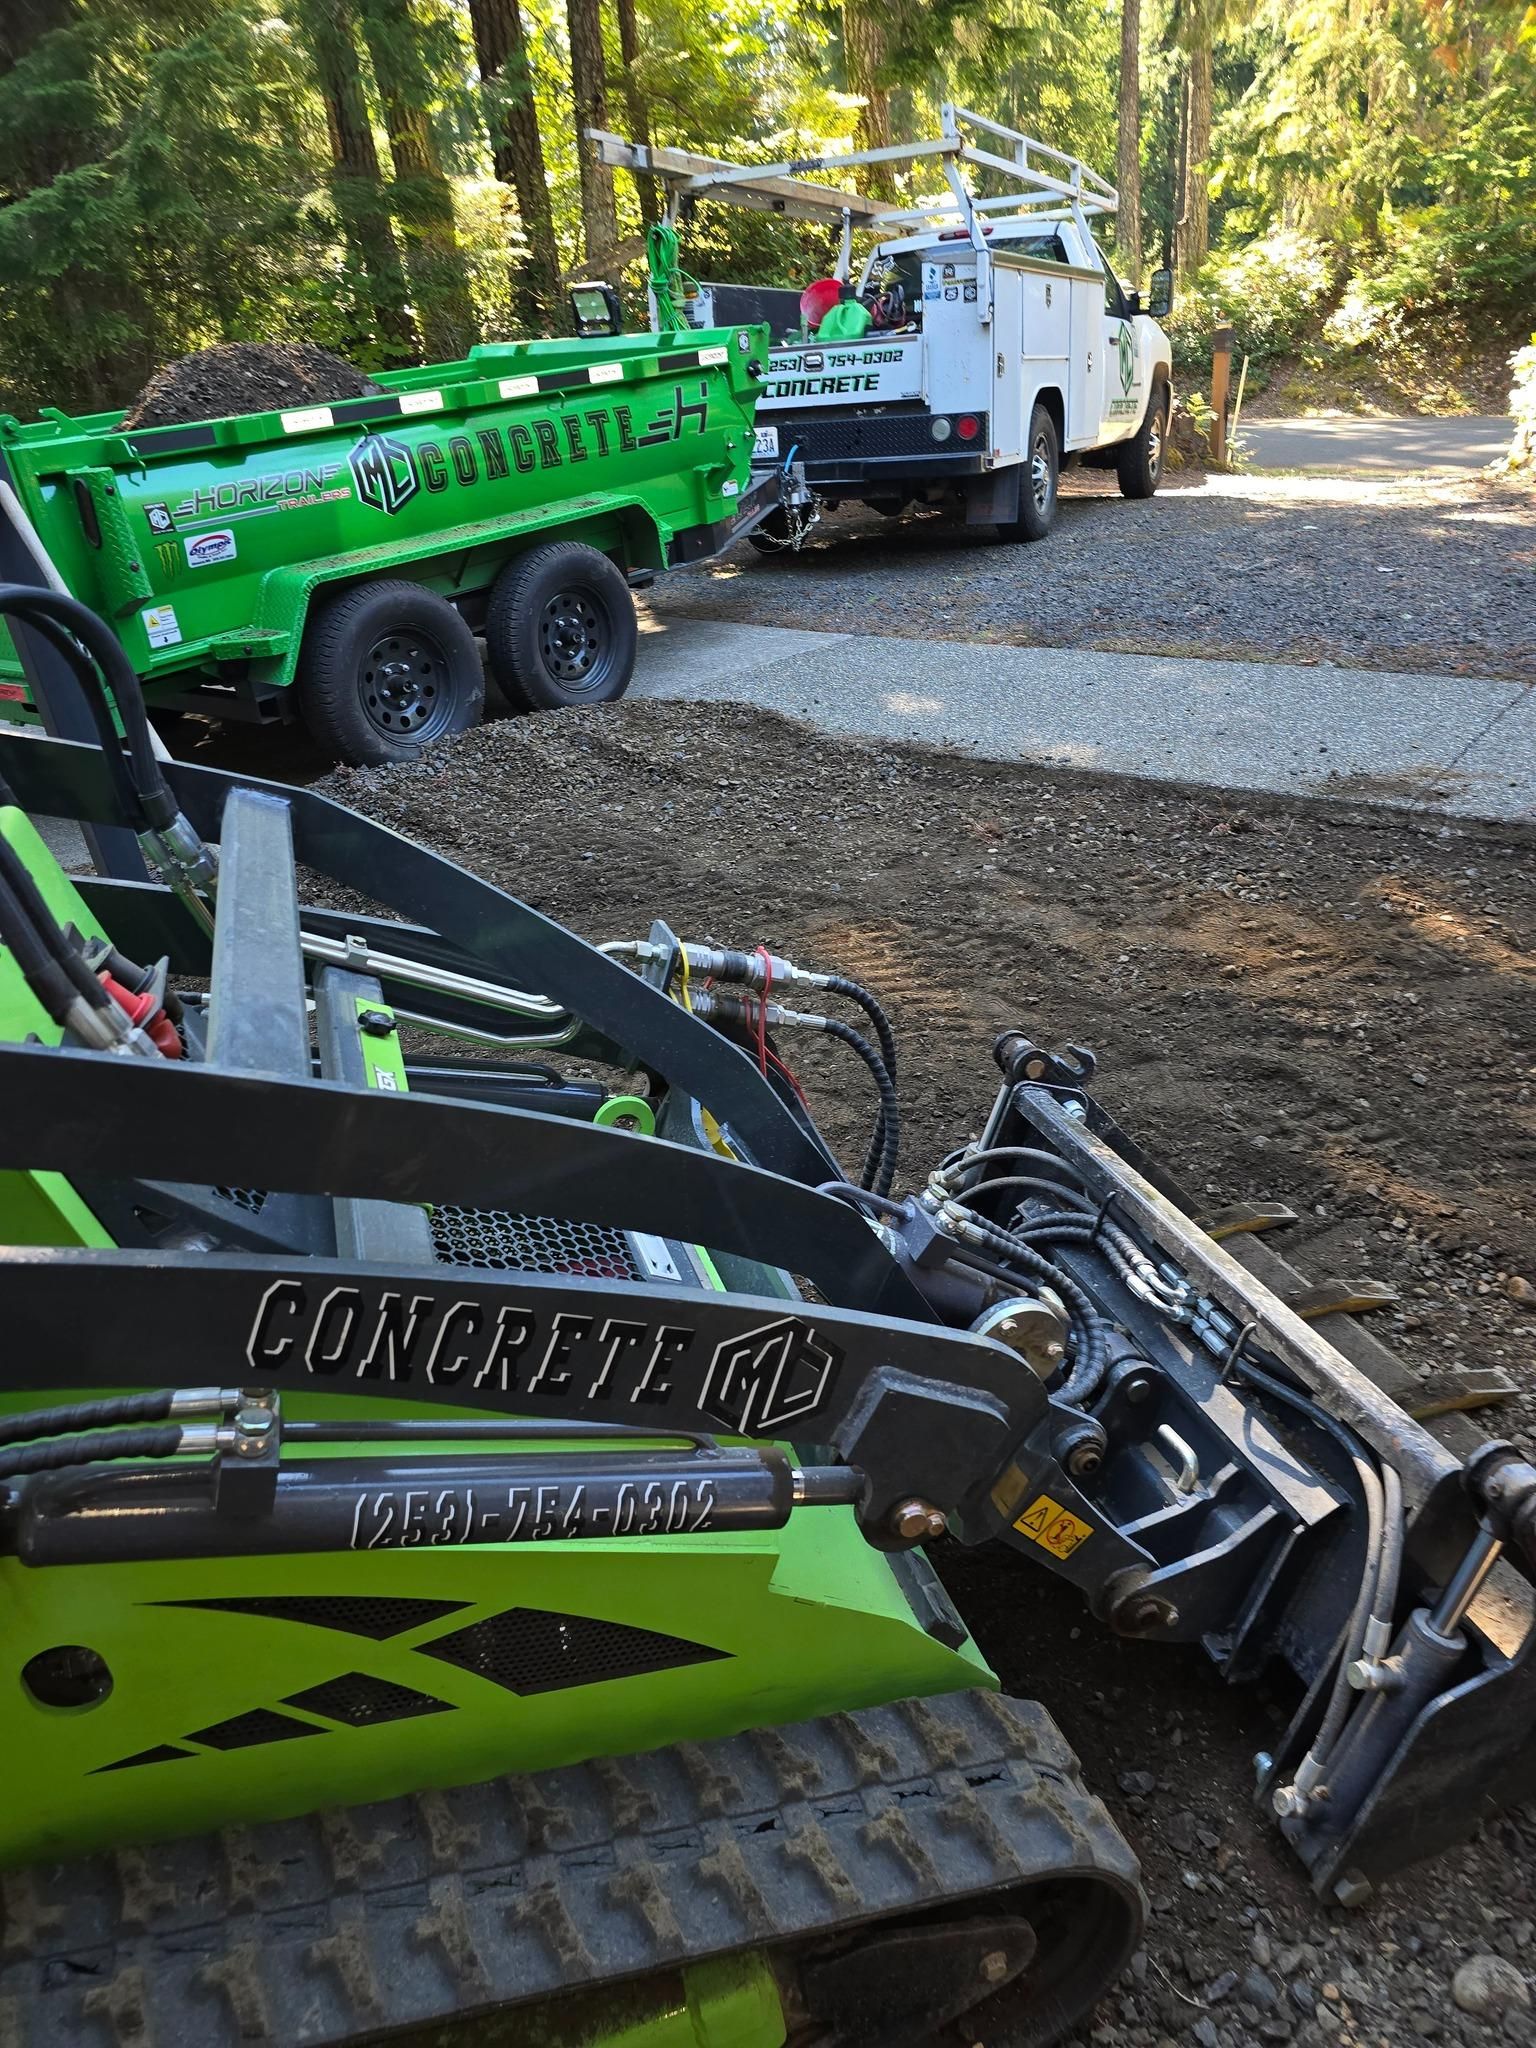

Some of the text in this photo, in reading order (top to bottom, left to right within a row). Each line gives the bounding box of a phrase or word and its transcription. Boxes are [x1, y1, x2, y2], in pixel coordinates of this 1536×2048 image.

[827, 349, 904, 368] 754-0302
[761, 374, 880, 399] CONCRETE
[417, 406, 637, 493] CONCRETE
[191, 464, 329, 514] HORIZON
[276, 487, 354, 511] TRAILERS
[245, 1279, 698, 1403] CONCRETE
[349, 1480, 716, 1550] (253)-754-0302
